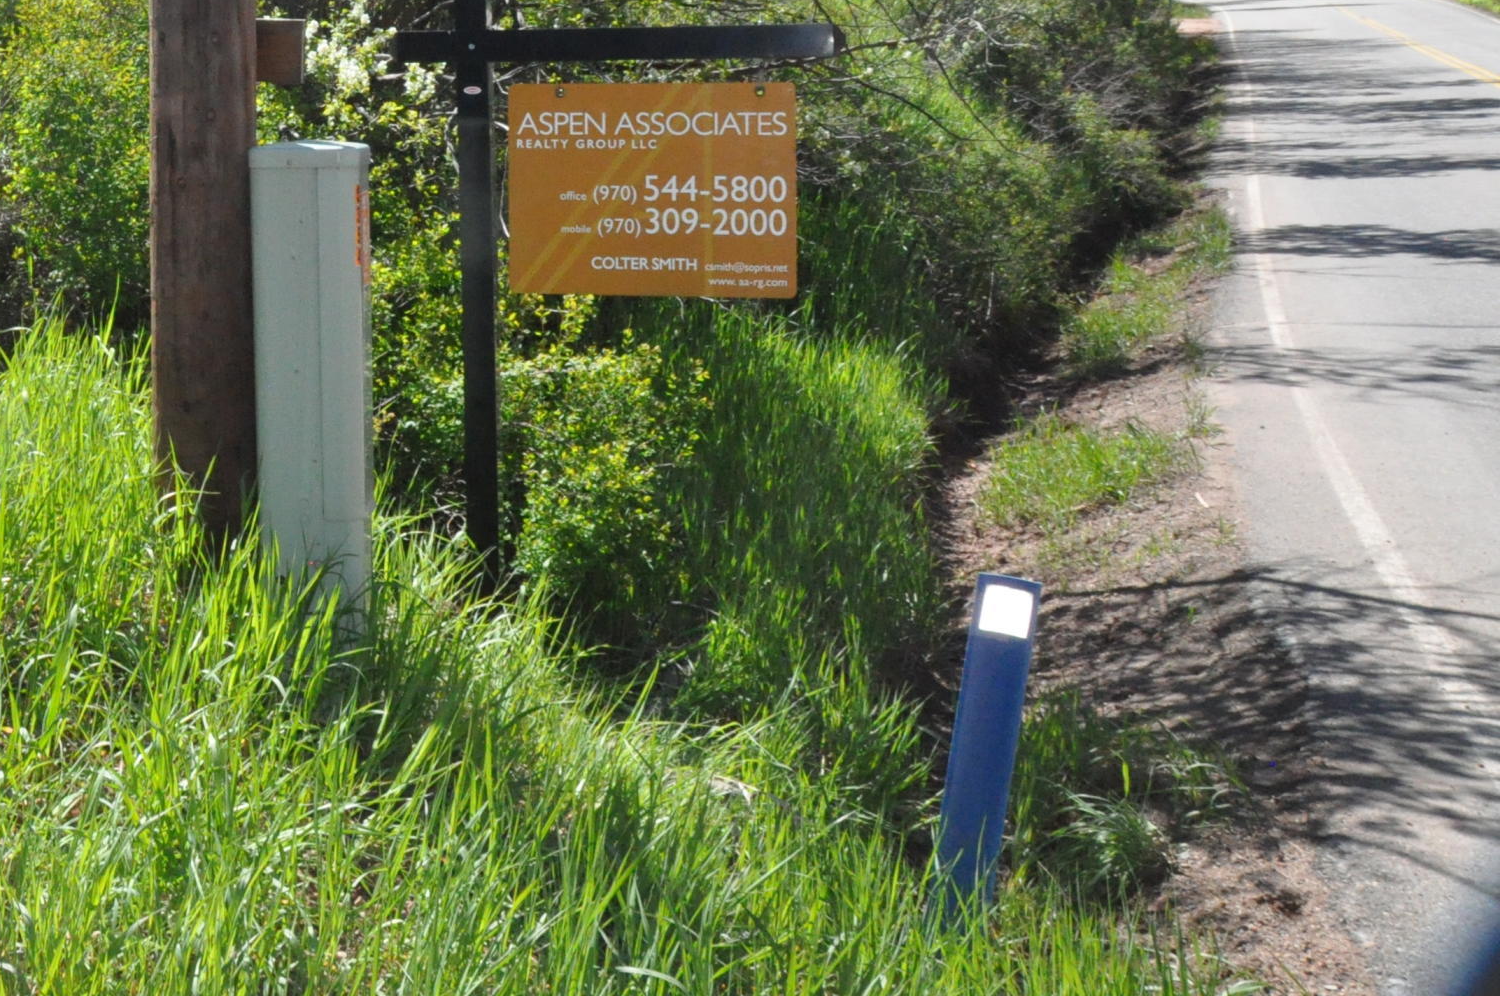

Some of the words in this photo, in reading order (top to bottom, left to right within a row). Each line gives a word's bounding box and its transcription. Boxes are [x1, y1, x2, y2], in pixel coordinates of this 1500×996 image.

[516, 111, 606, 136] ASPEN
[614, 111, 788, 136] ASSOCIATES
[516, 138, 569, 150] REALTY
[575, 138, 626, 150] GROUP
[632, 138, 658, 150] LLC
[559, 190, 588, 202] office
[592, 184, 637, 206] (970)
[643, 174, 788, 203] 544-5800
[560, 224, 592, 235] mobile
[596, 217, 641, 238] (970)
[644, 207, 788, 237] 309-2000
[590, 256, 649, 271] COLTER
[651, 257, 698, 272] SMITH
[704, 261, 789, 274] csmith@sopris.net
